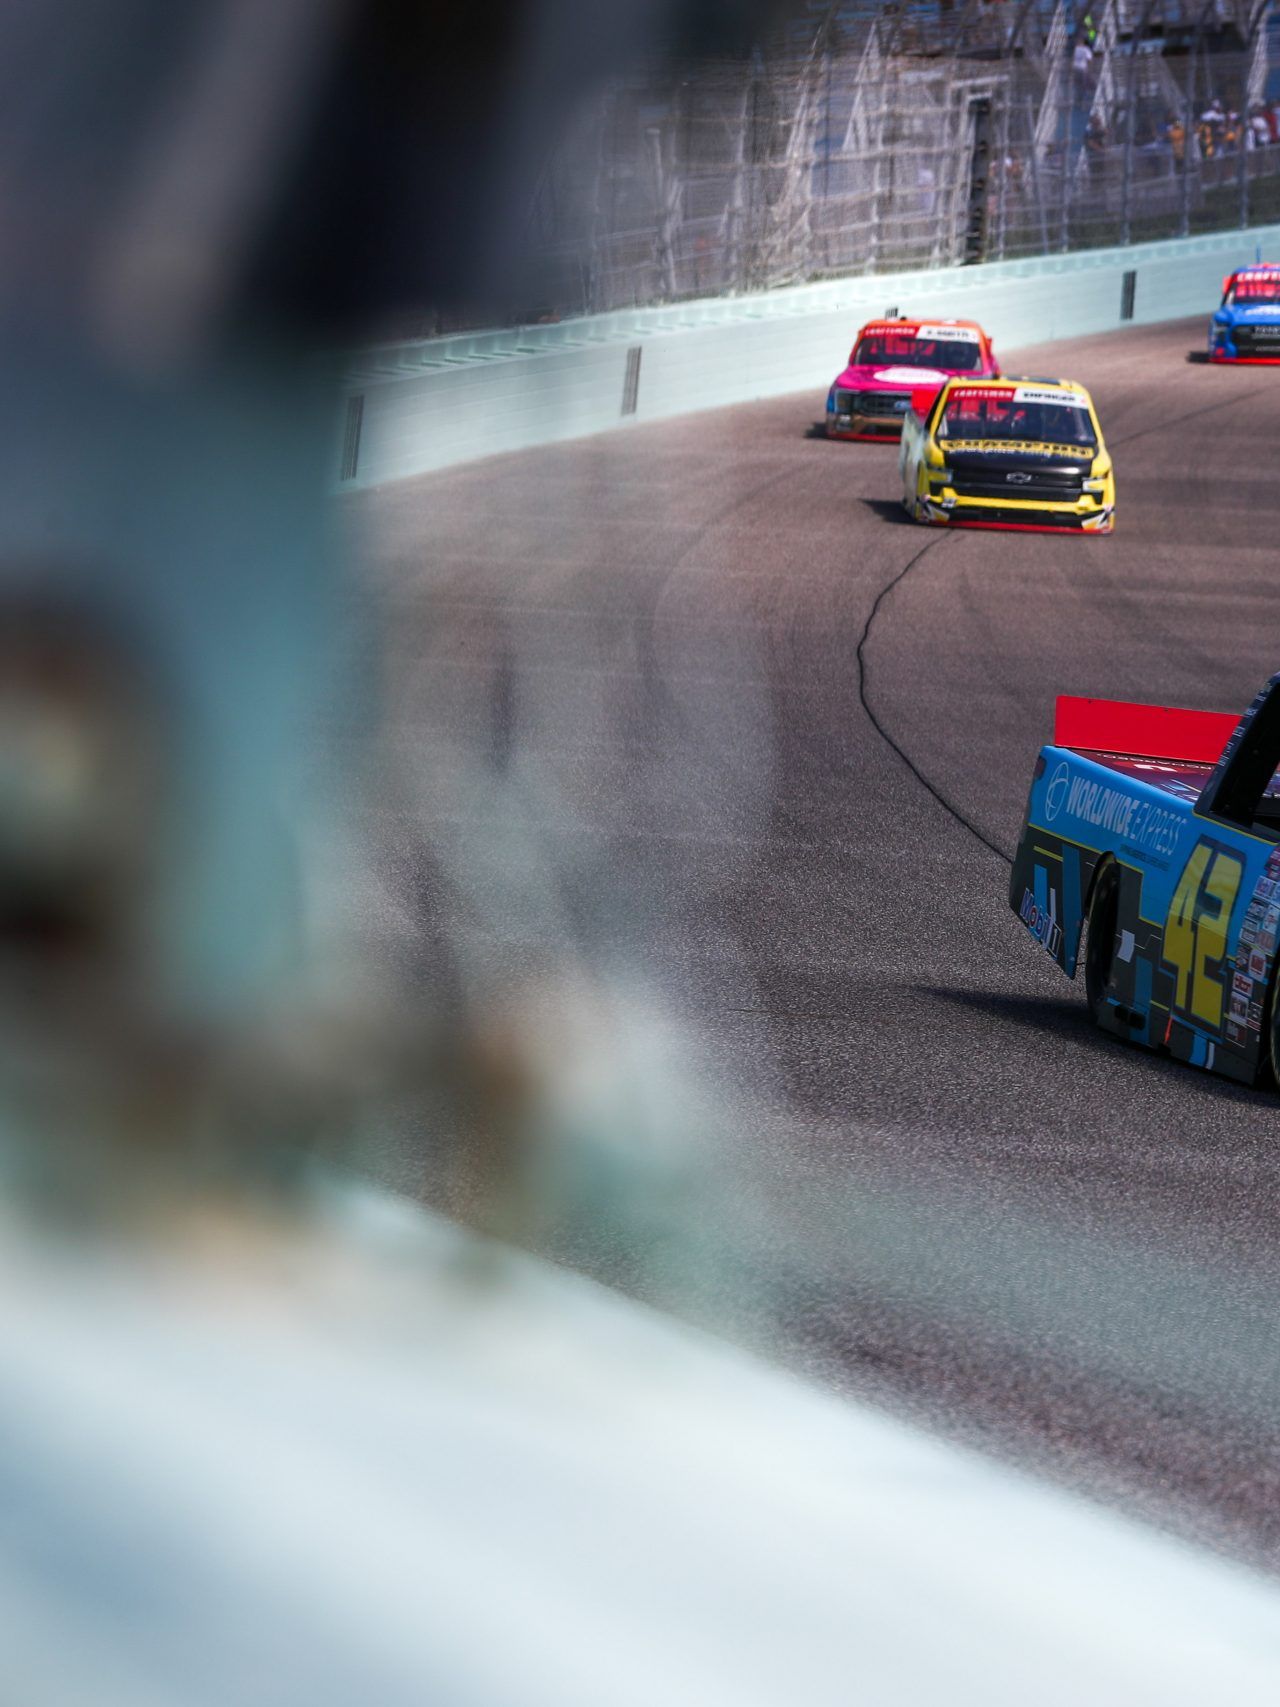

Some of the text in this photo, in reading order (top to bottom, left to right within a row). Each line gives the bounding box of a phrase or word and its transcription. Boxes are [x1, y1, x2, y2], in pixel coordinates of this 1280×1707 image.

[1065, 775, 1188, 856] WORLDWIDE EXPRESS
[1019, 888, 1053, 951] Mobil
[1162, 841, 1245, 1030] 42
